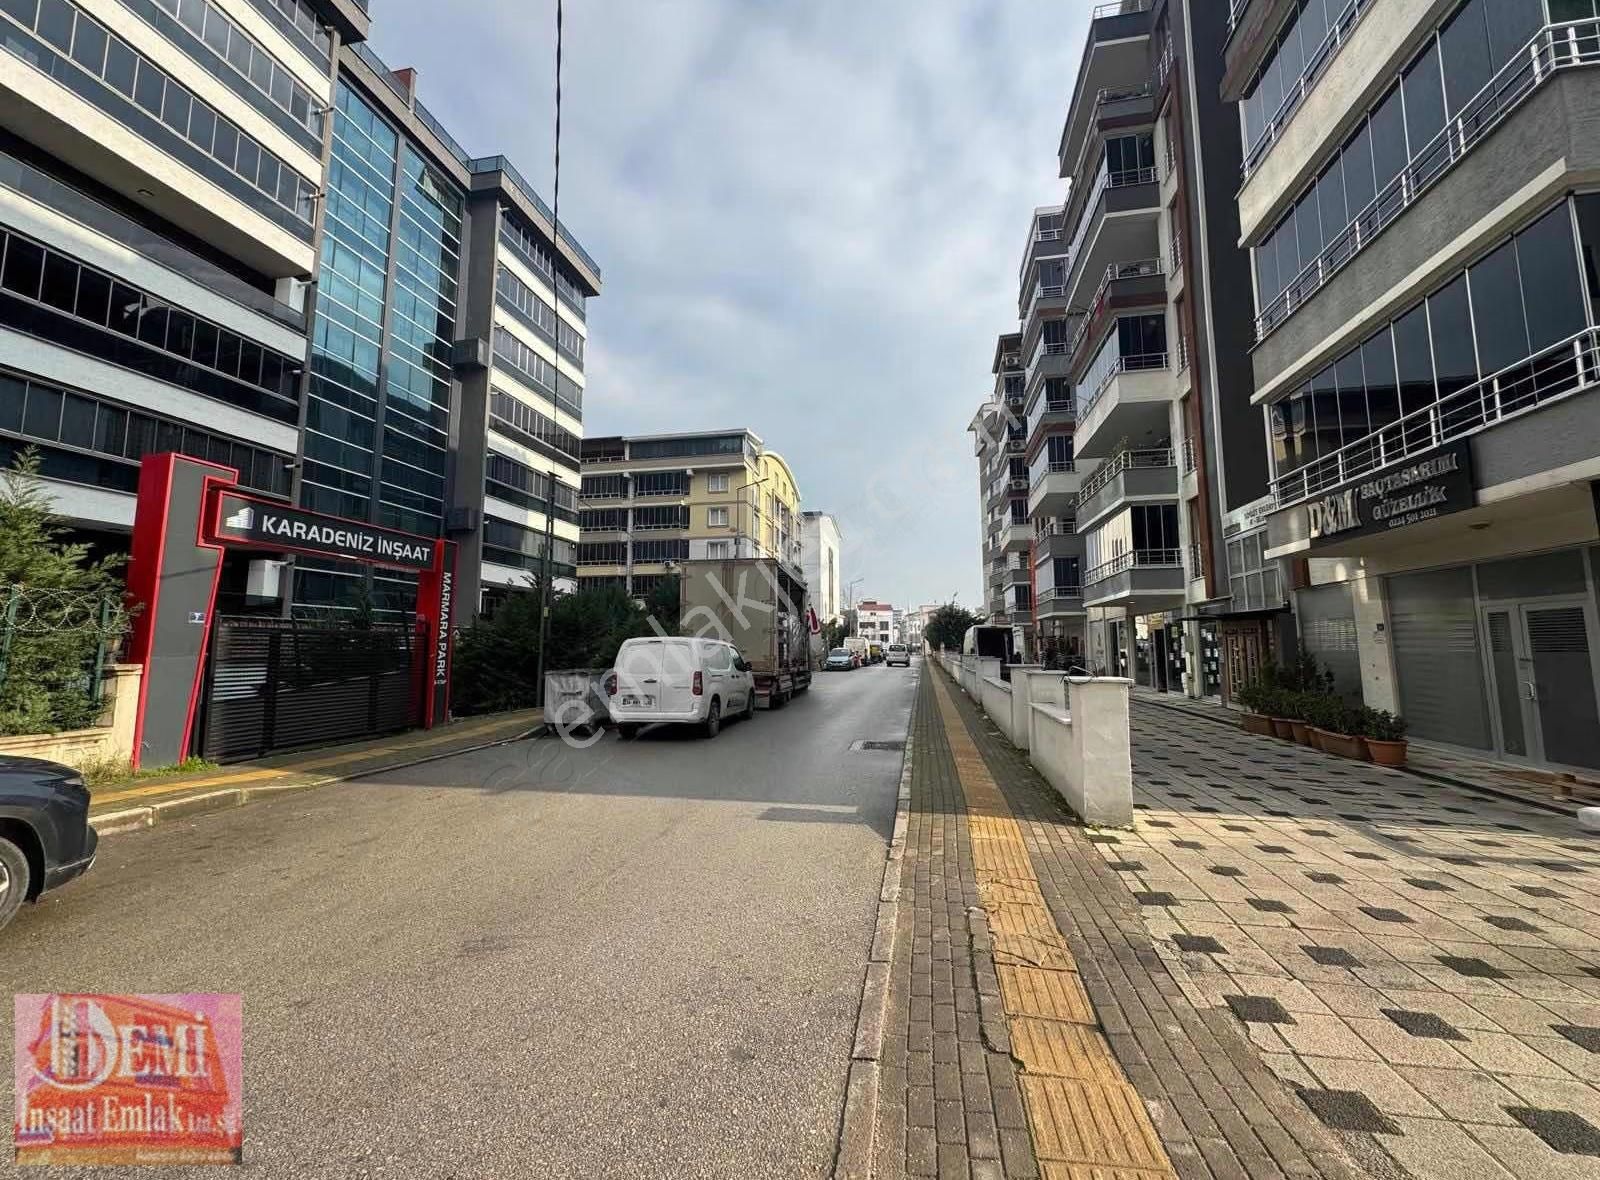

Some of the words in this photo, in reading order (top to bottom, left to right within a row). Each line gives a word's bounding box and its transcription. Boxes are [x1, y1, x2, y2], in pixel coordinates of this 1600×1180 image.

[262, 515, 374, 552] KARADENİZ
[377, 535, 431, 562] İNŞAAT
[439, 572, 452, 639] MARMARA
[436, 642, 448, 677] PARK
